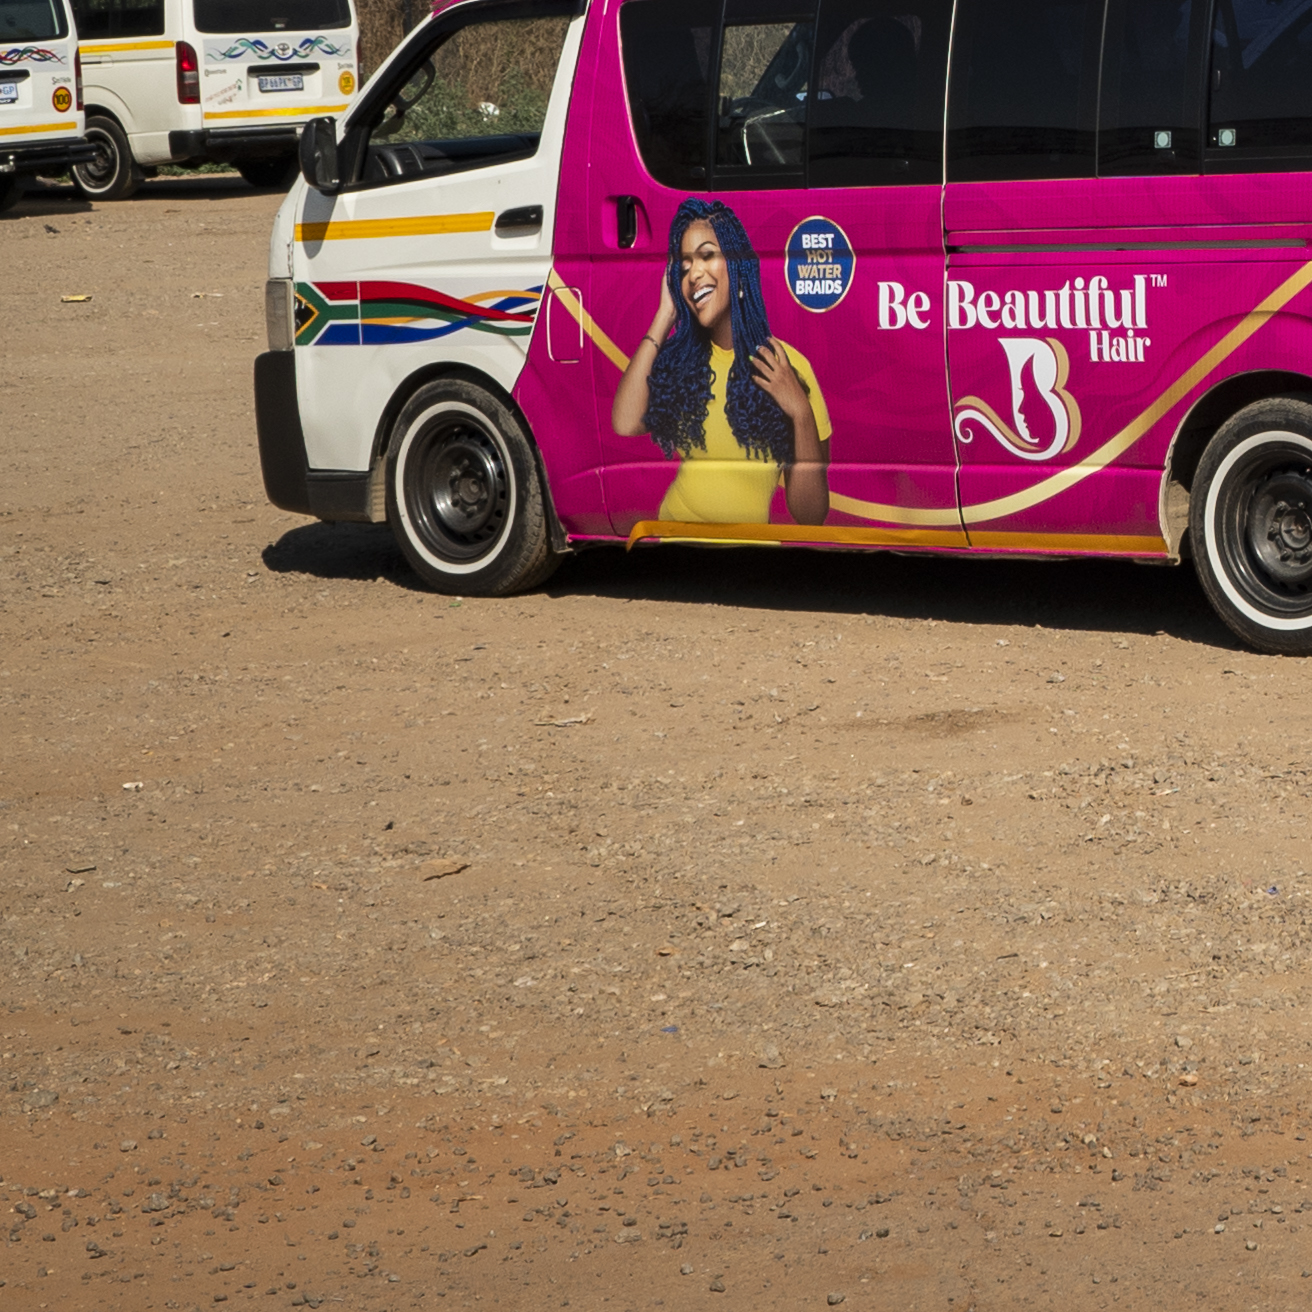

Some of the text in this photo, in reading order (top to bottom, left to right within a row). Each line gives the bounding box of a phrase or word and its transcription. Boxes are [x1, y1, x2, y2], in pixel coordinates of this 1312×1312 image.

[55, 94, 70, 105] 100
[802, 233, 834, 248] BEST
[807, 249, 833, 264] HOT
[798, 264, 842, 280] WATER
[796, 279, 843, 295] BRAIDS
[877, 281, 931, 330] Be
[1089, 329, 1151, 362] Hair
